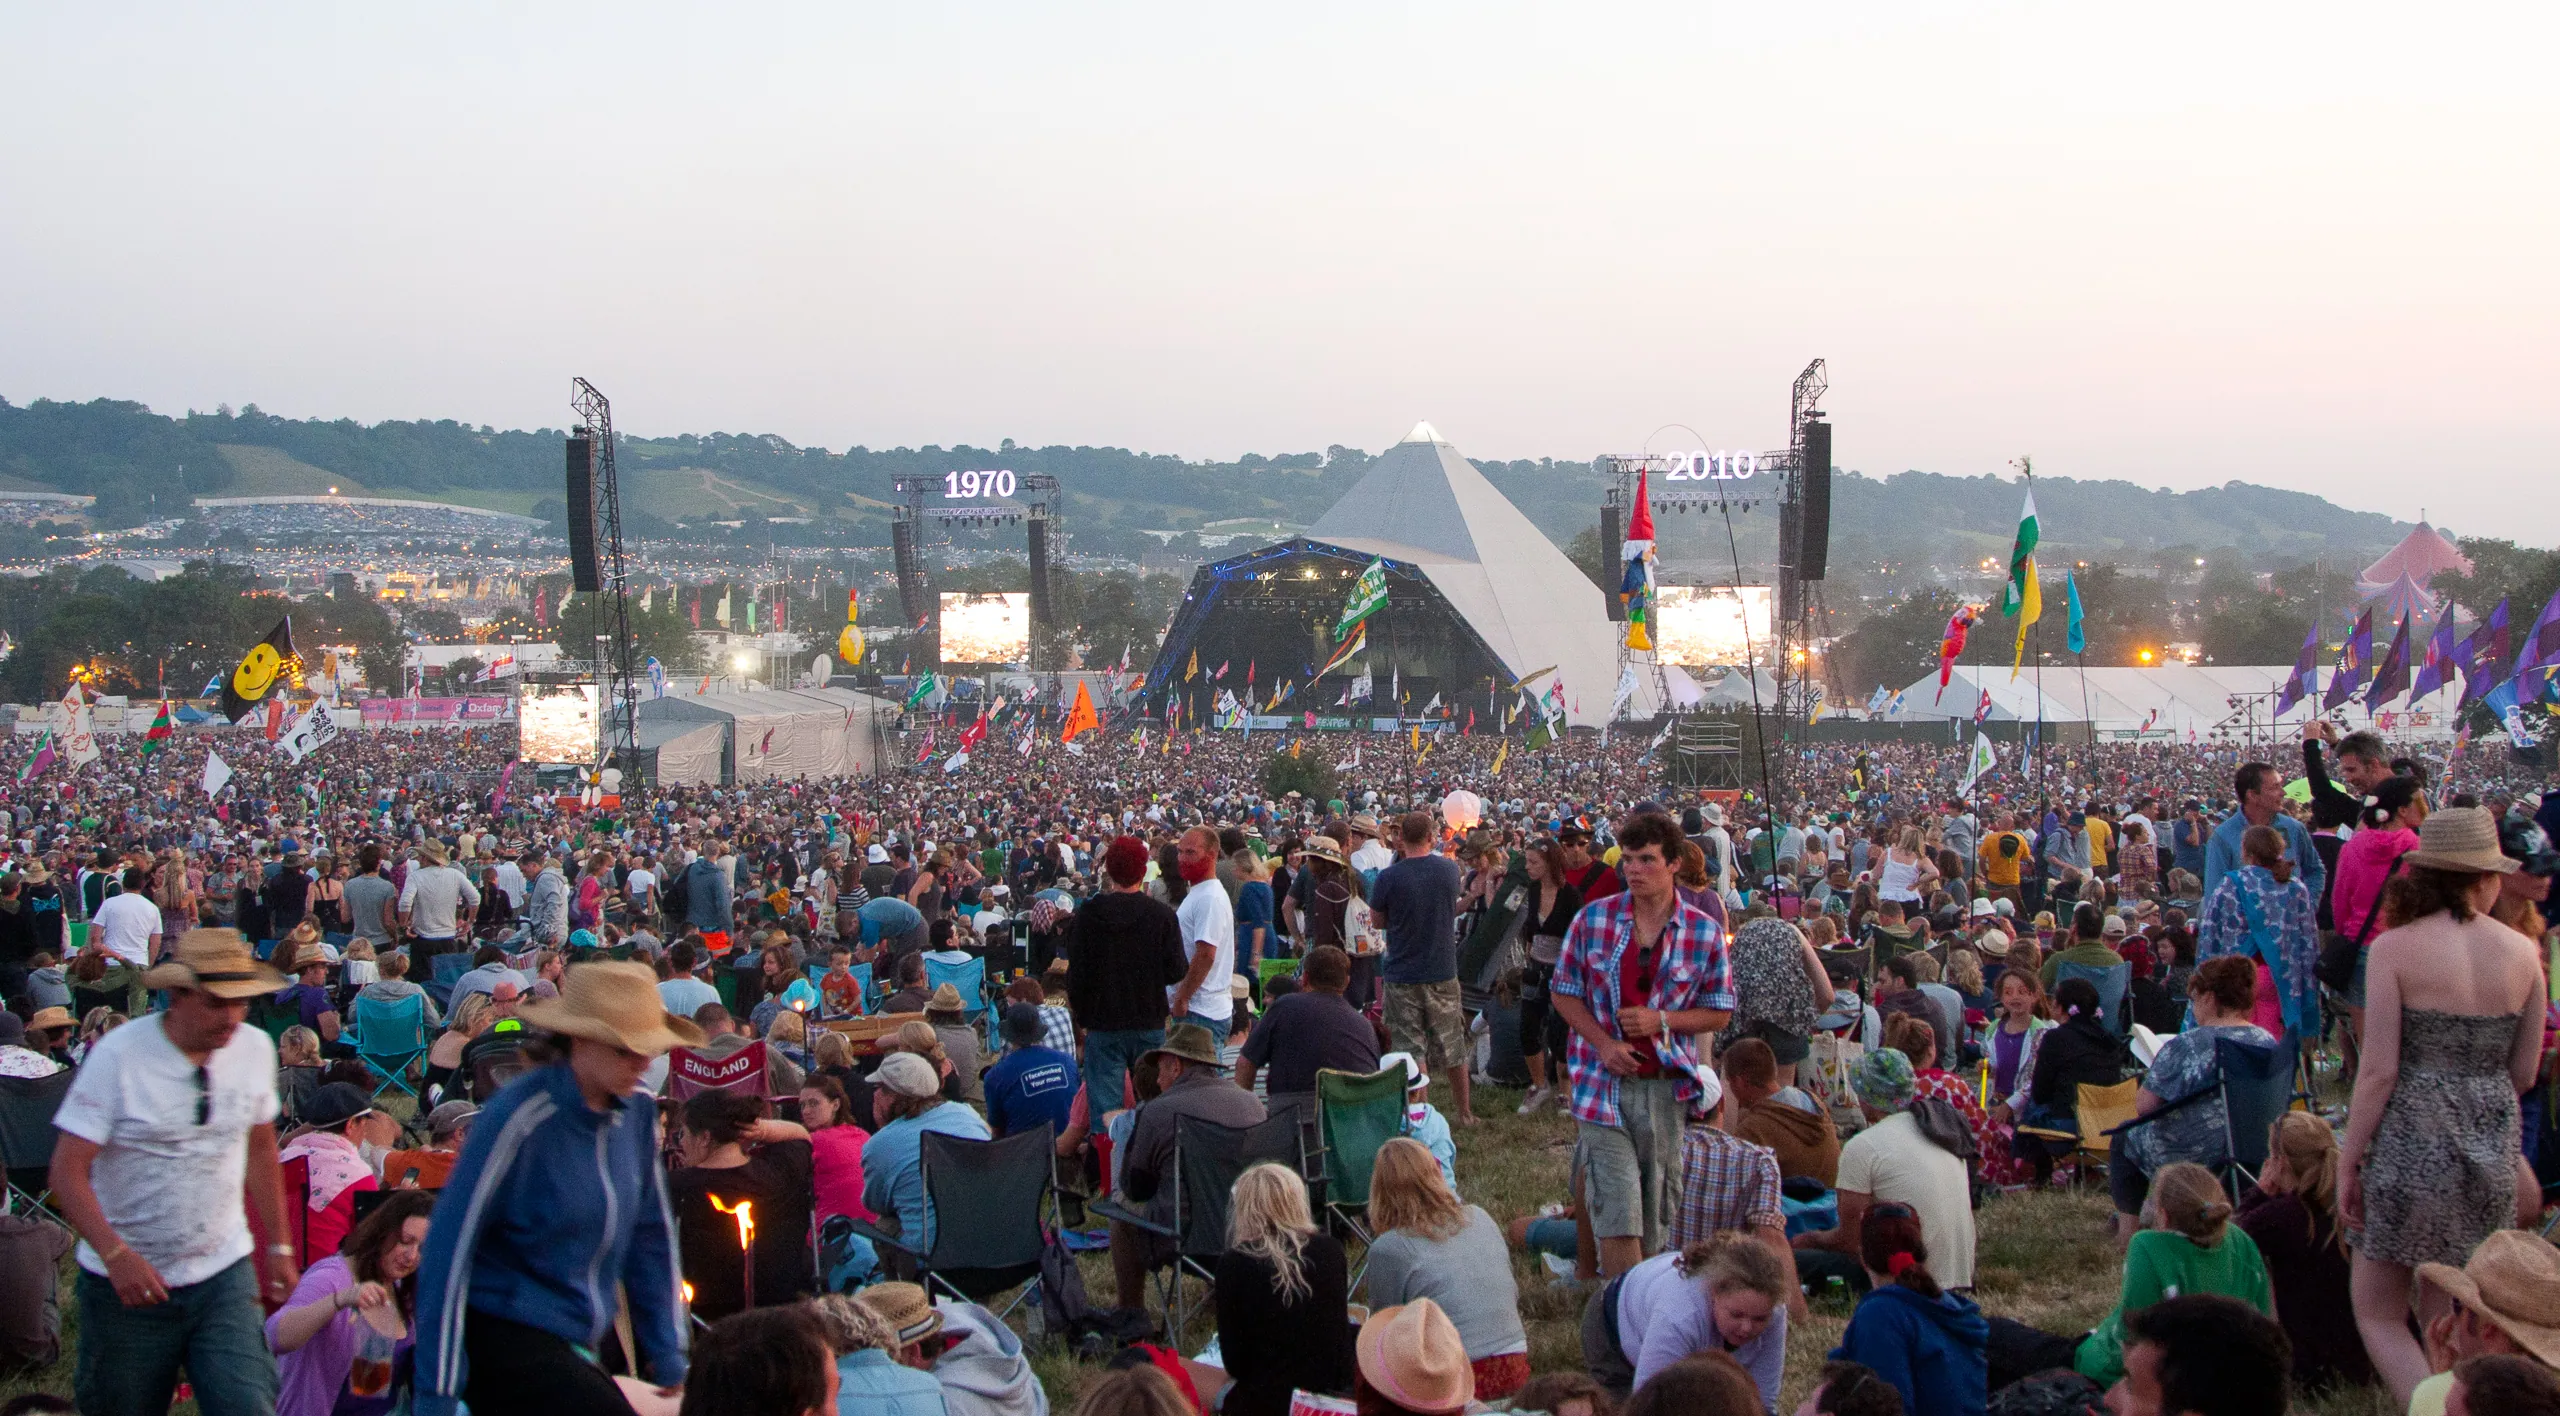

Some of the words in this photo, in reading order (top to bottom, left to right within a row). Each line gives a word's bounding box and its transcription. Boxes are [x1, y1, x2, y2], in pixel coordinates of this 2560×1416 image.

[1665, 449, 1756, 481] 2010
[945, 470, 1016, 499] 1970
[684, 1057, 750, 1079] ENGLAND
[1028, 1067, 1062, 1080] facebooked
[1030, 1079, 1045, 1088] Your
